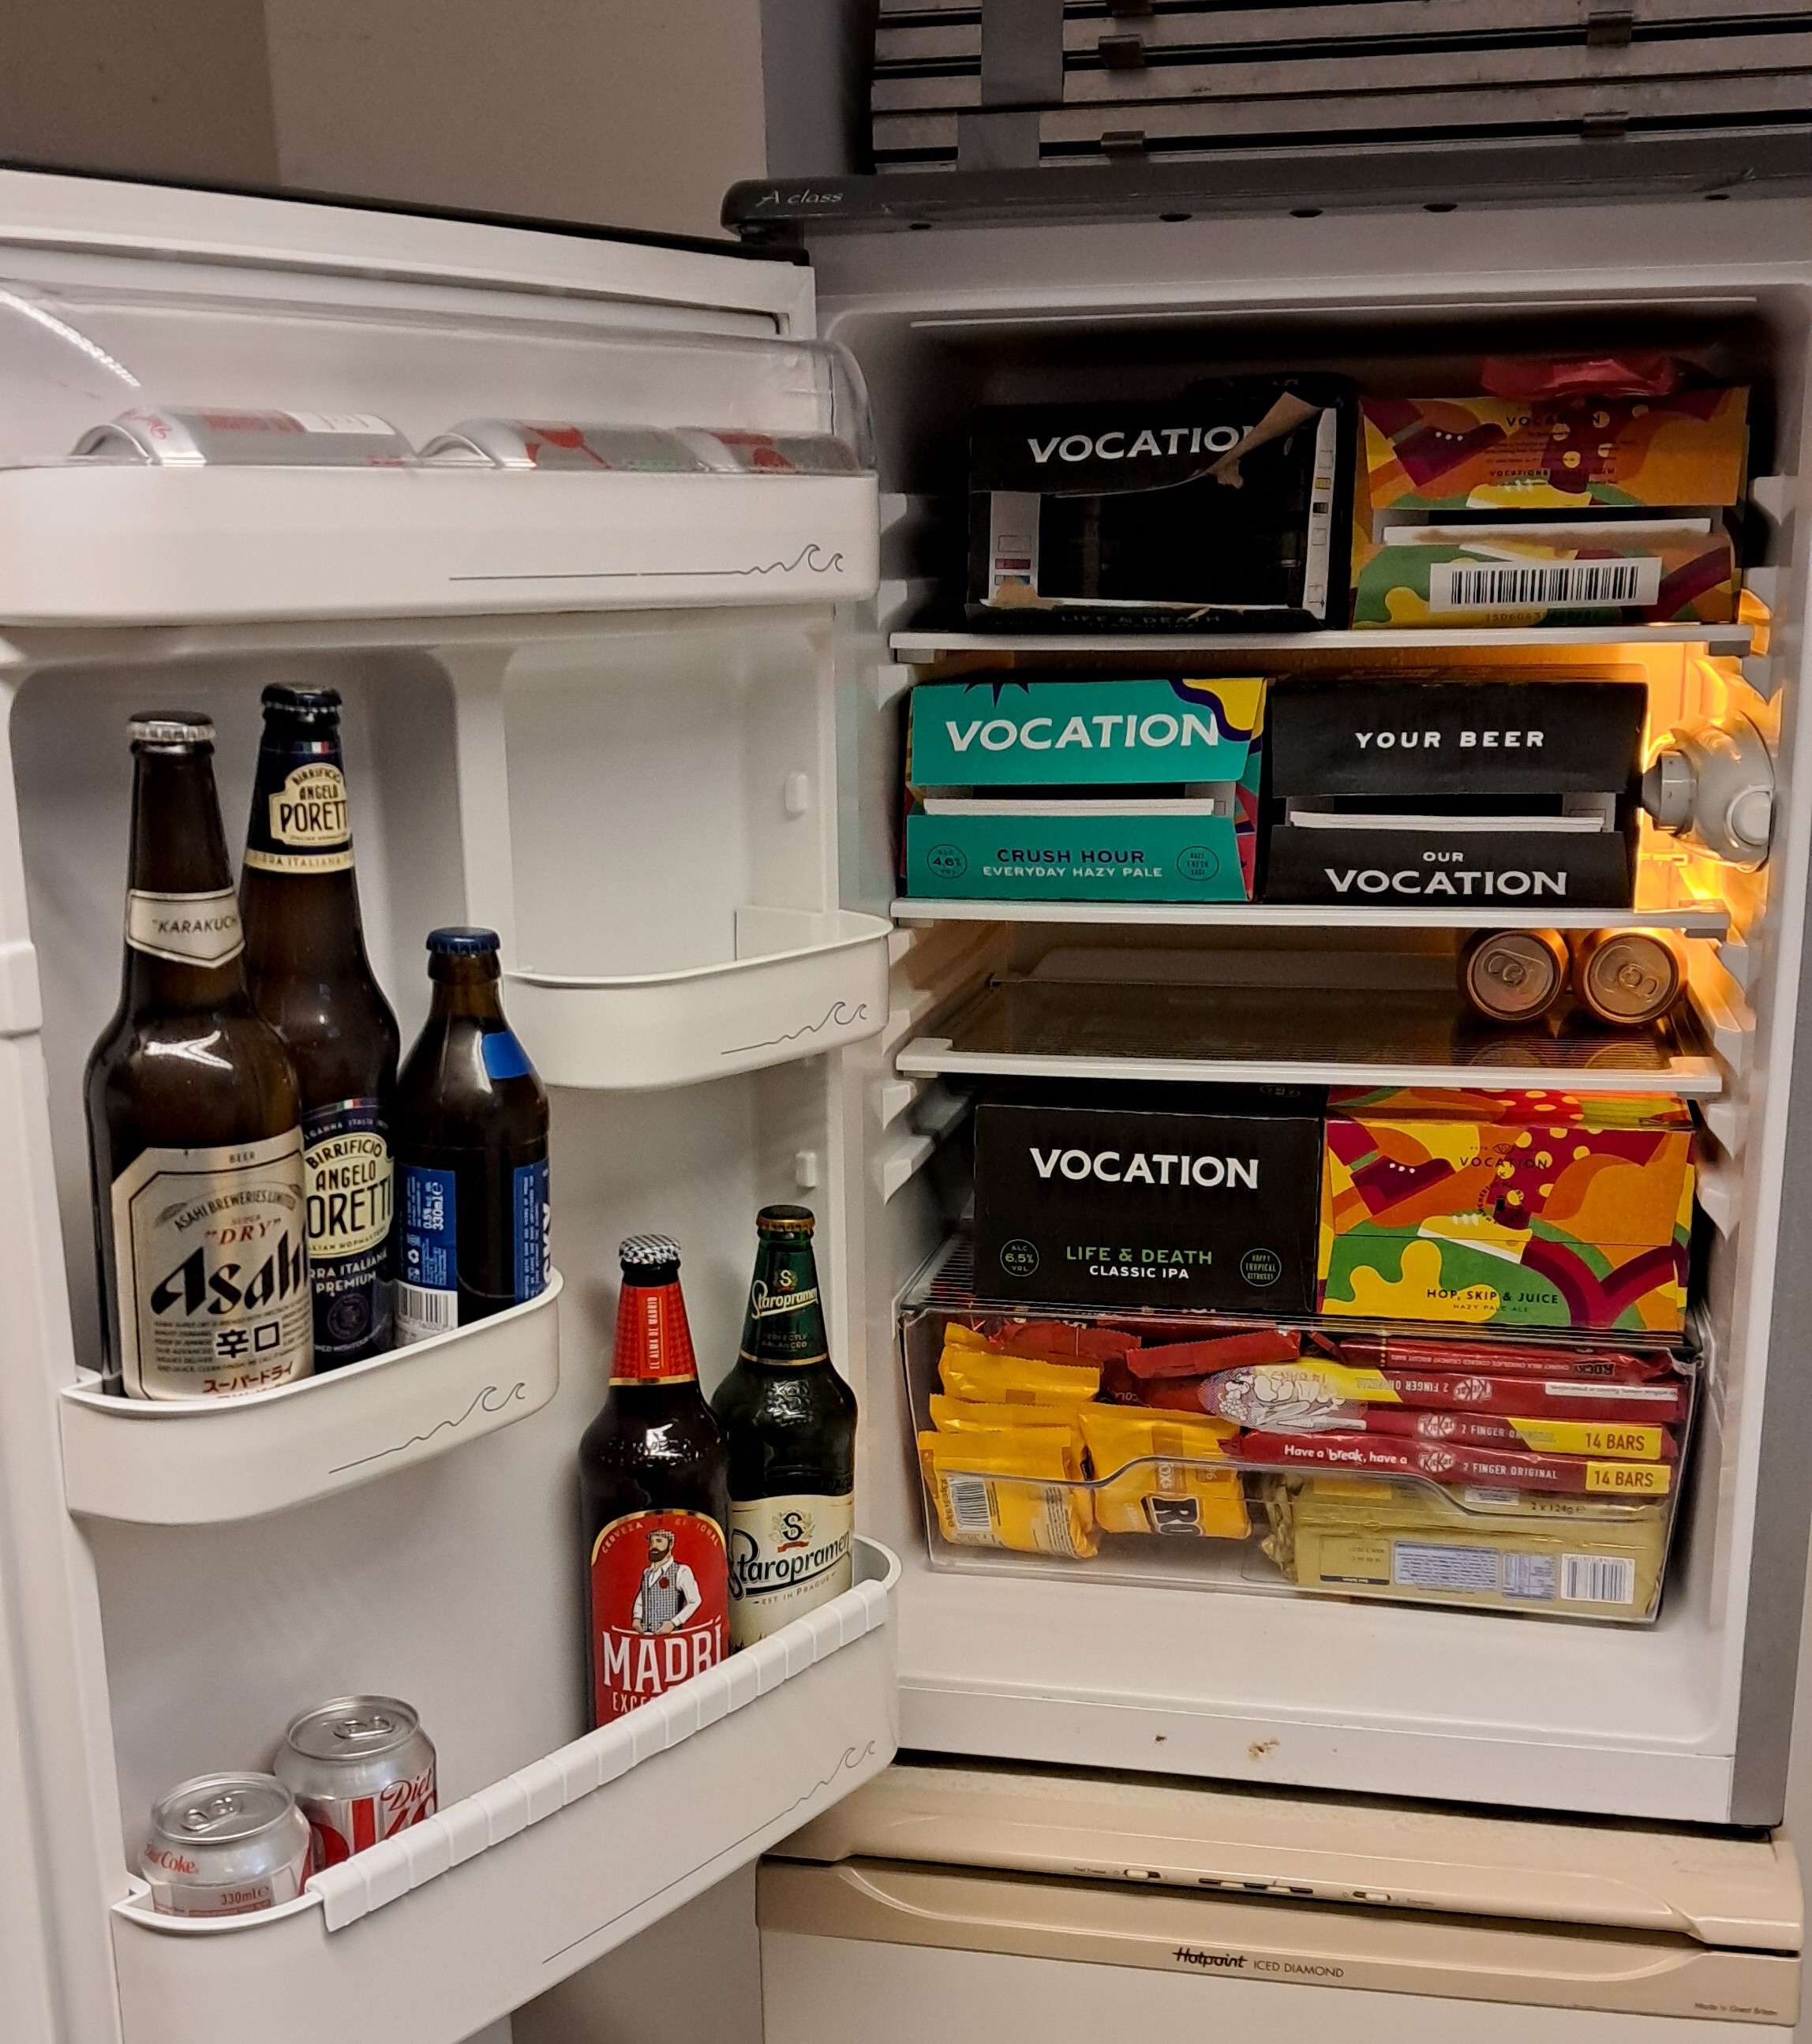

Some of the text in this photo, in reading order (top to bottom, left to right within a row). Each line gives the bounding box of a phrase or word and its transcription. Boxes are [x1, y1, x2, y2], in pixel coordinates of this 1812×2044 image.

[755, 189, 844, 207] A class
[945, 713, 1219, 752] VOCATION
[1355, 731, 1544, 748] YOUR BEER
[279, 799, 346, 833] PORETT
[997, 848, 1145, 864] CRUSH HOUR
[1423, 852, 1465, 863] OUR
[983, 866, 1163, 878] EVERYDAY HAZY PALE
[1324, 869, 1567, 896] VOCATION
[229, 1151, 255, 1162] BEER
[305, 1139, 383, 1170] BIRRIFICIO
[1459, 1156, 1548, 1169] VOCATION
[316, 1160, 376, 1192] ANGELO
[1029, 1147, 1259, 1190] VOCATION
[174, 1204, 207, 1233] ASAHI
[208, 1190, 267, 1215] BREWERIES
[305, 1175, 391, 1240] ORETTI
[1005, 1252, 1035, 1263] 6.5%
[1066, 1246, 1213, 1265] LIFE & DEATH
[309, 1266, 336, 1279] RRA
[1089, 1265, 1190, 1279] CLASSIC IPA
[316, 1271, 377, 1294] PREMIUM
[1427, 1289, 1559, 1305] HOP, SKIP & JUICE
[215, 1321, 280, 1358] 辛口
[203, 1361, 294, 1393] スーパードライ
[1405, 1382, 1439, 1394] FINGER
[1443, 1383, 1449, 1393] 2
[1461, 1424, 1466, 1434] 2
[1471, 1425, 1504, 1437] FINGER
[1586, 1432, 1645, 1451] 14 BARS
[1284, 1443, 1314, 1457] Have
[1369, 1451, 1397, 1464] have
[1399, 1455, 1408, 1465] a
[1463, 1462, 1558, 1480] 2 FINGER ORIGINAL
[1594, 1470, 1653, 1488] 14 BARS
[1530, 1502, 1537, 1511] 2
[1549, 1504, 1574, 1515] 124g
[762, 1596, 778, 1605] EST
[796, 1576, 830, 1596] PRAGUE
[380, 1767, 432, 1812] Diet
[161, 1851, 196, 1874] Coke
[1173, 1946, 1345, 1978] Hotpoint ICED DIAMOND
